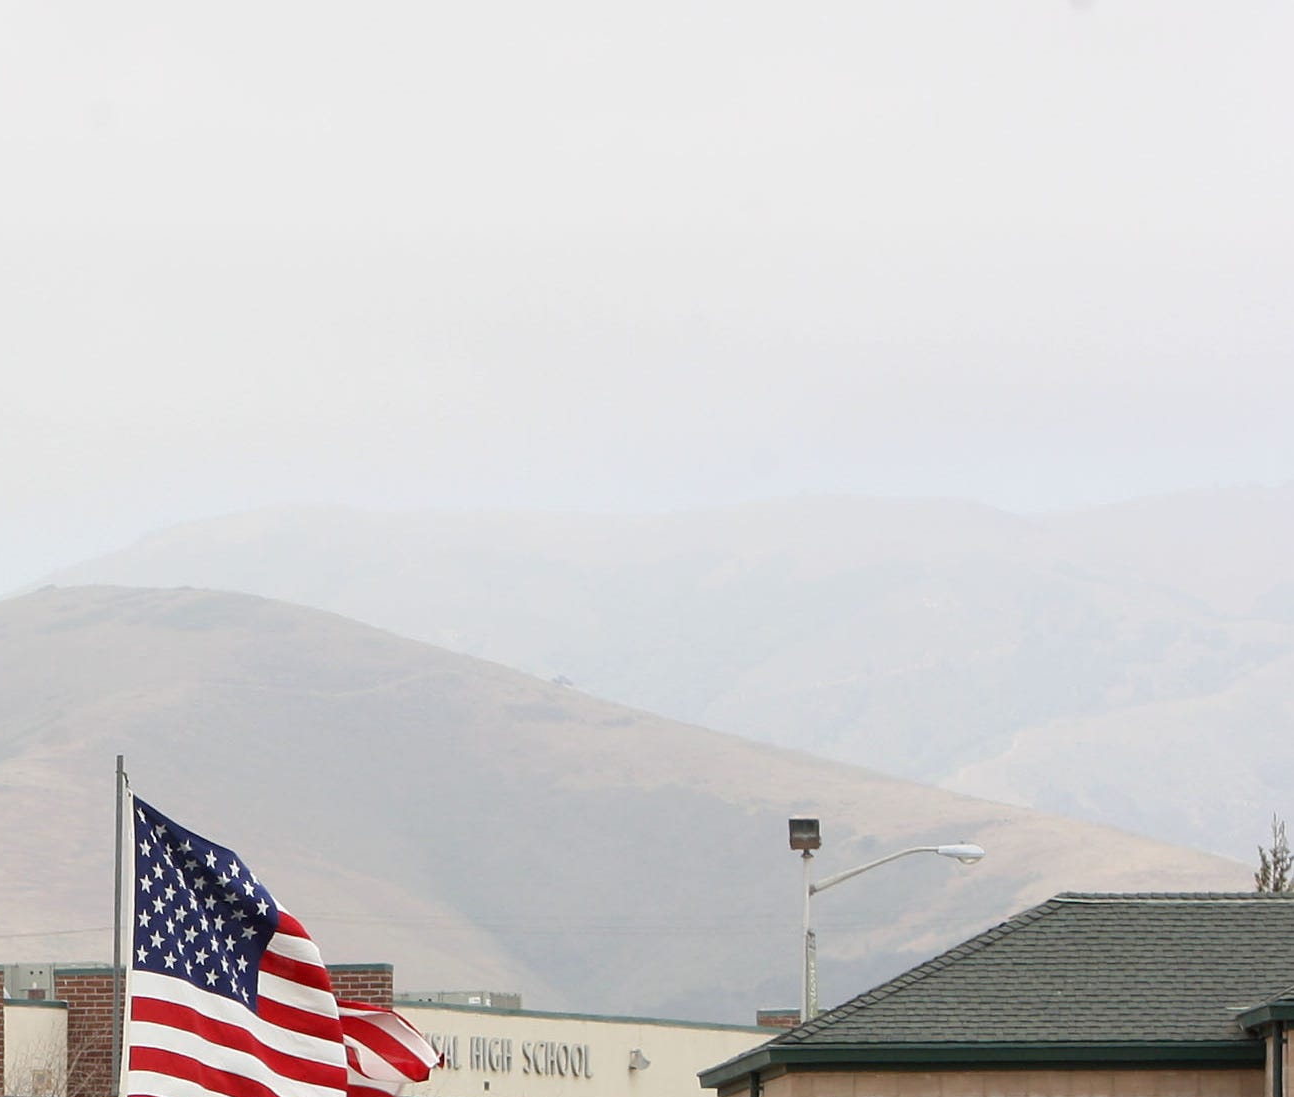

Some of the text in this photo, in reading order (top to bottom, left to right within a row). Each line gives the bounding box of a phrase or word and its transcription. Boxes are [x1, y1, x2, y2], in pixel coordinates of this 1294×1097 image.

[425, 1033, 594, 1079] SAL HIGH SCHOOL
